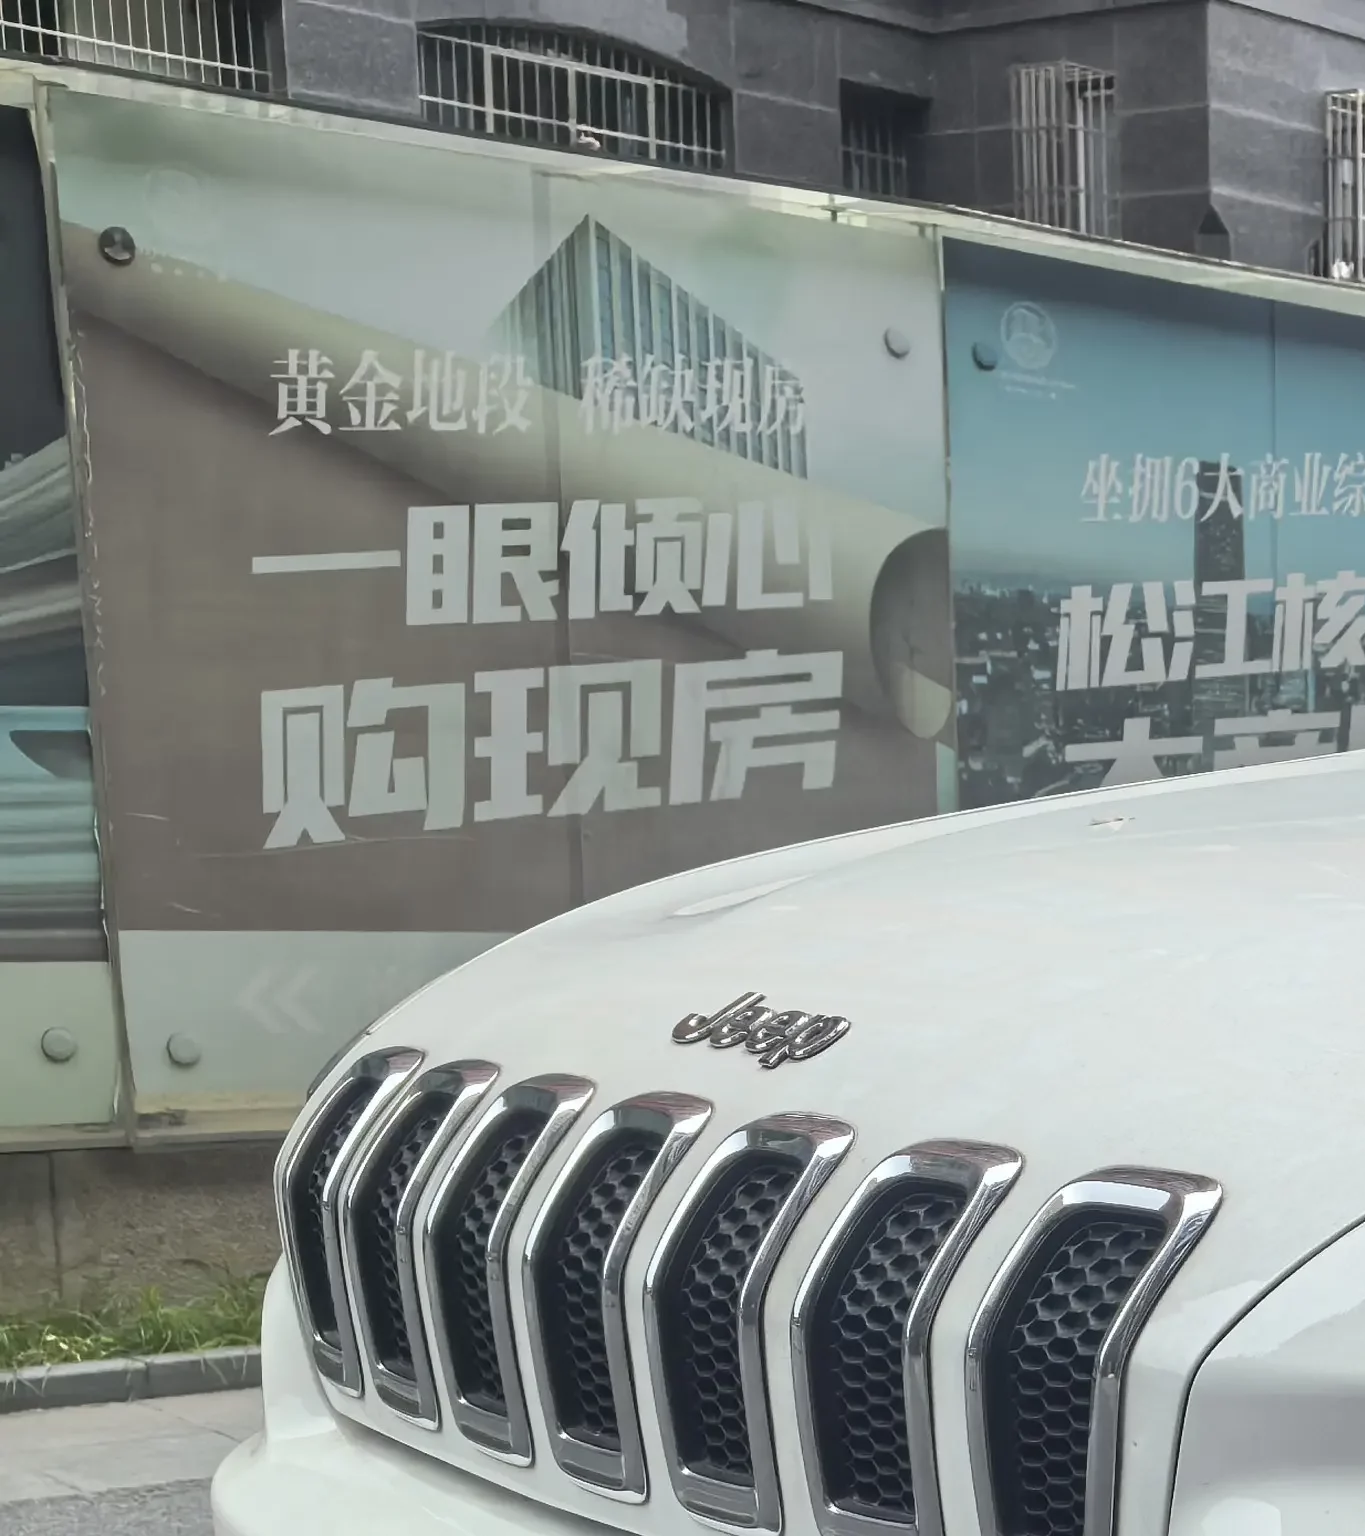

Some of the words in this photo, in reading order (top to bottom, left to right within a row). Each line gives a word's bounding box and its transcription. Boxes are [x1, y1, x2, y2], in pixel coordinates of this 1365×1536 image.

[268, 348, 536, 436] 黄金地段
[579, 354, 808, 437] 稀缺现房
[252, 499, 834, 626] 一眼倾心
[260, 649, 844, 849] 购现房
[671, 991, 851, 1069] Jeep
